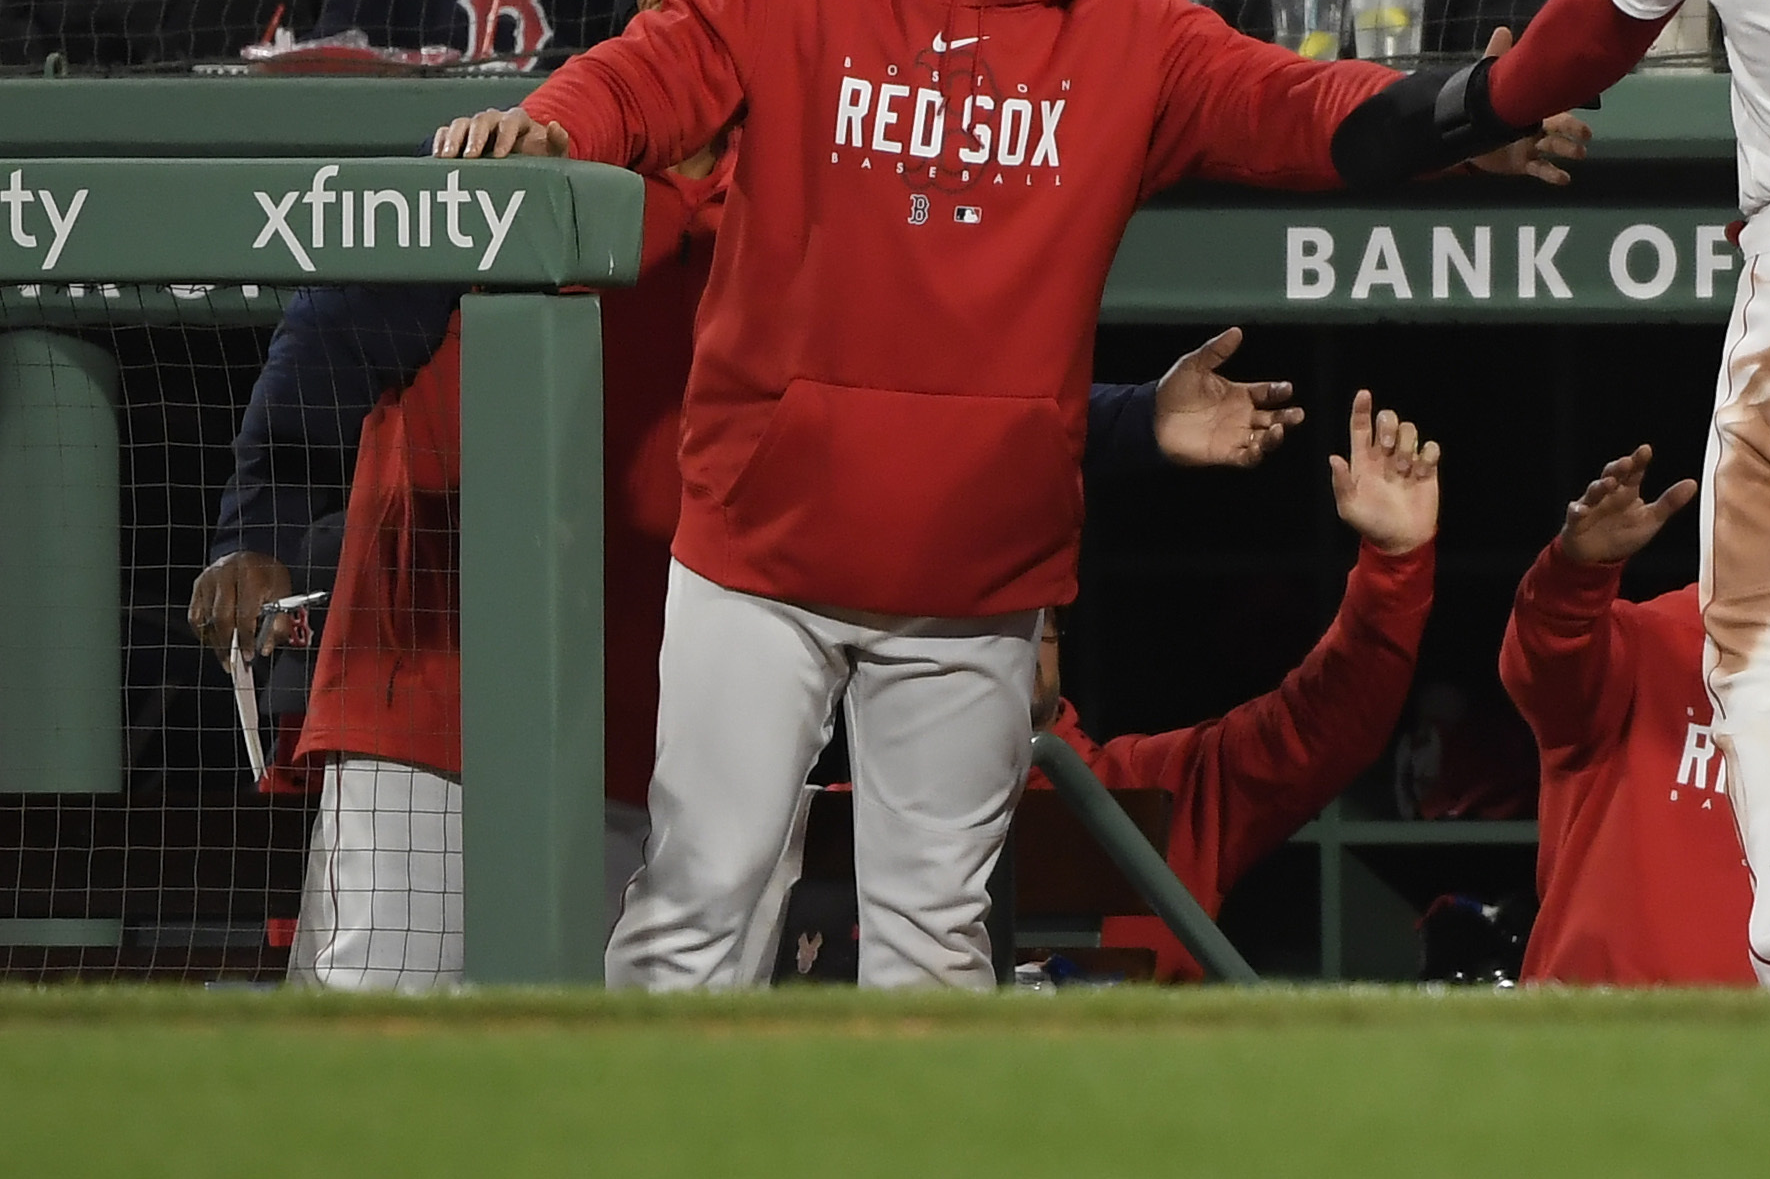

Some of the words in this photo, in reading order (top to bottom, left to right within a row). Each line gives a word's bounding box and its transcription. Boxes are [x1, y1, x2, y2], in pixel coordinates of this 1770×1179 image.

[844, 56, 1071, 93] BOSTON
[835, 76, 947, 158] RED
[959, 94, 1066, 167] SOX
[831, 152, 1062, 187] BASEBALL
[252, 165, 526, 272] xfinity
[907, 194, 930, 225] B
[1286, 226, 1573, 299] BANK
[1609, 223, 1733, 300] OF
